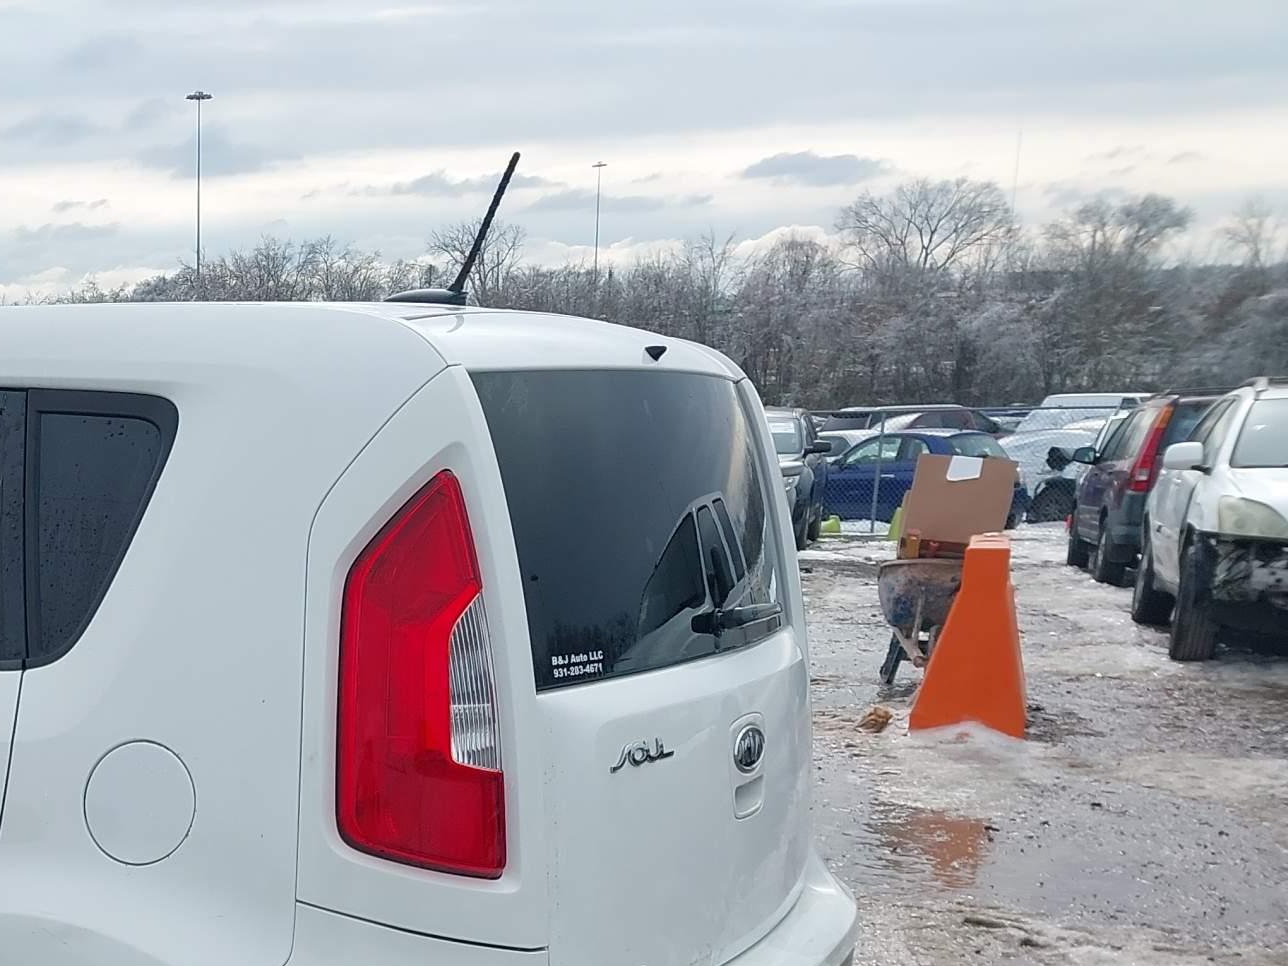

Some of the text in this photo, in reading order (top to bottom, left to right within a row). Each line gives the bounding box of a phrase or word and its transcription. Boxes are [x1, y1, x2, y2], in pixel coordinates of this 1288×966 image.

[551, 650, 604, 666] B&J Auto LLC
[610, 737, 674, 774] SOUL
